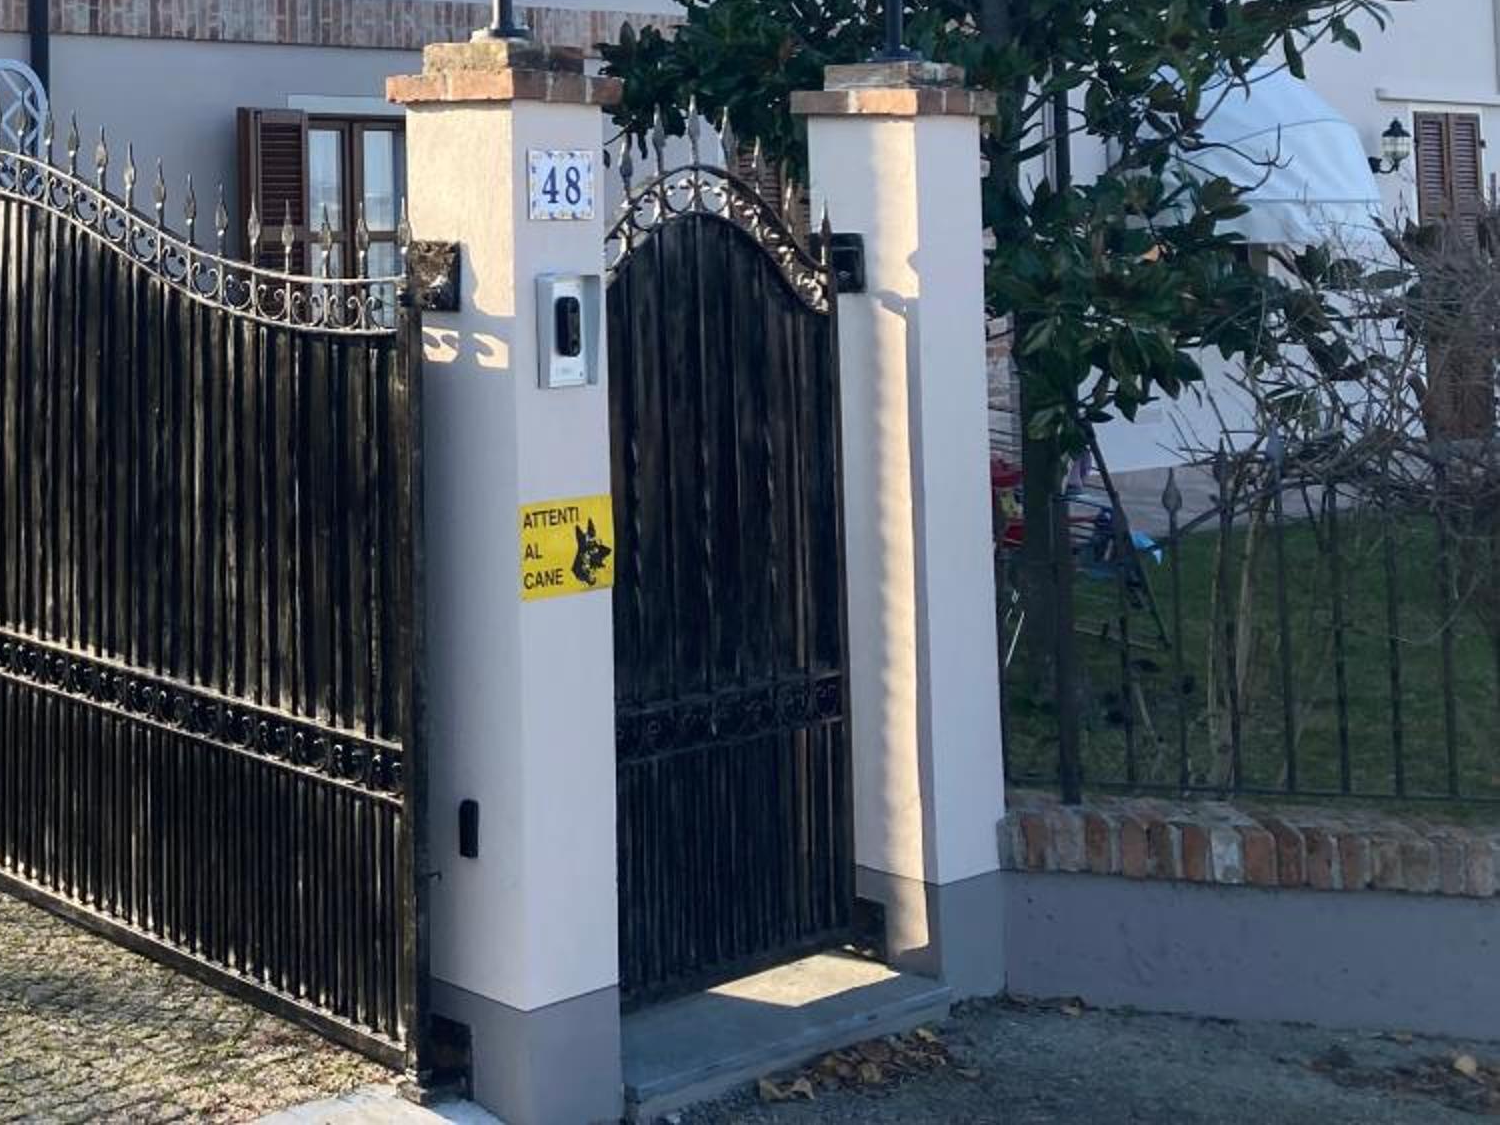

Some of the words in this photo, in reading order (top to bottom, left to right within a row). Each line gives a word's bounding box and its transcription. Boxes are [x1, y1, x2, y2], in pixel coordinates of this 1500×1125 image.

[542, 166, 580, 205] 48
[523, 506, 579, 529] ATTENTI
[525, 543, 543, 560] AL
[523, 568, 564, 589] CANE
